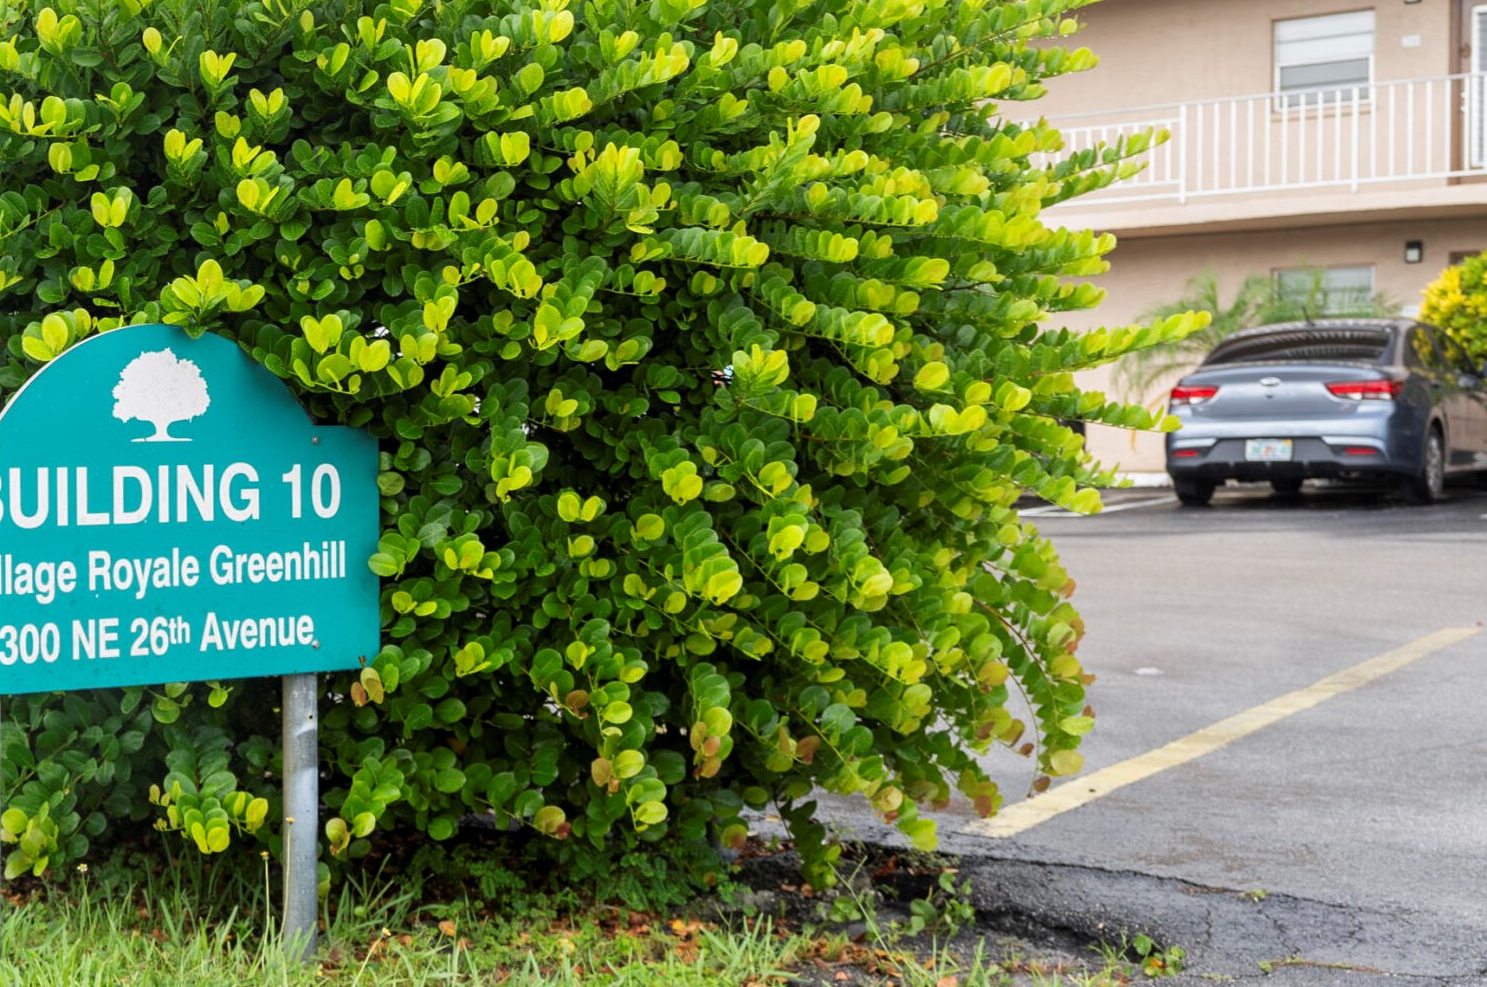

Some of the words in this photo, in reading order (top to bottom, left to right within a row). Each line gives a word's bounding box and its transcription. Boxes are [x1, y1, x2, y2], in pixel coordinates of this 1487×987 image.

[282, 463, 342, 519] 10
[88, 547, 200, 599] Royale
[210, 540, 346, 584] Greenhill
[72, 617, 120, 661] NE
[130, 615, 191, 656] 26th
[200, 611, 314, 652] Avenue
